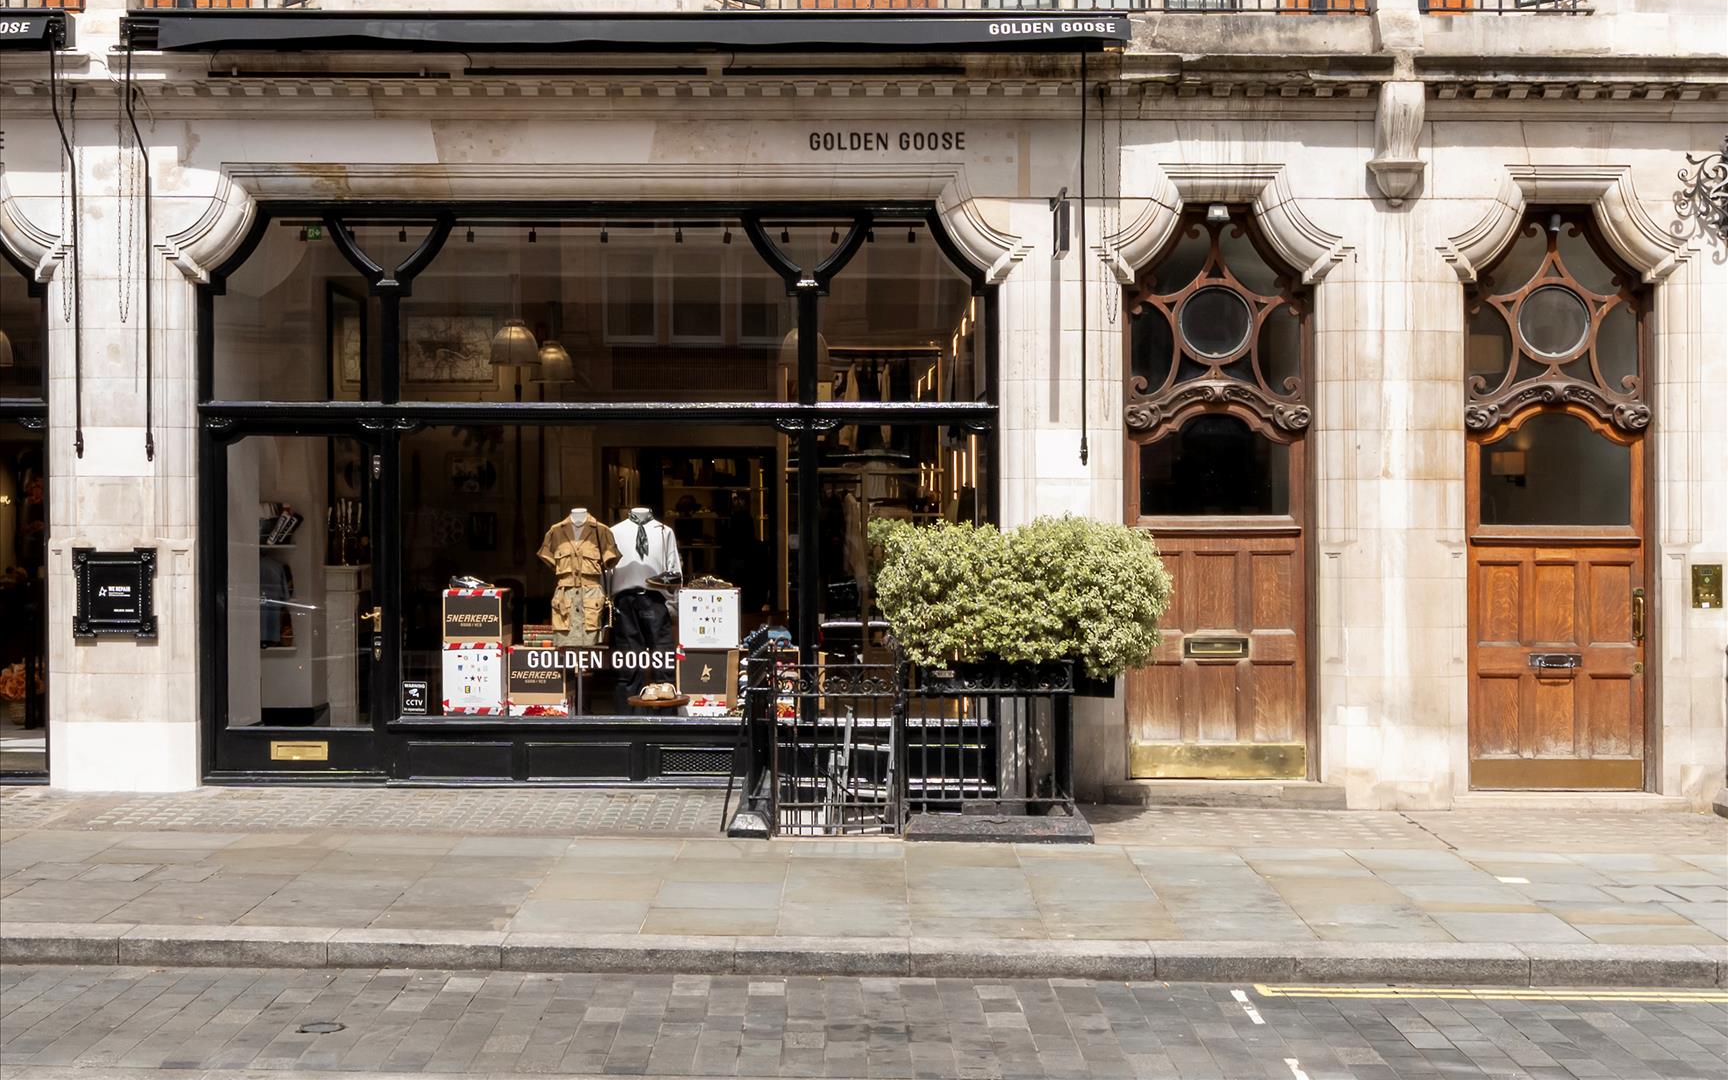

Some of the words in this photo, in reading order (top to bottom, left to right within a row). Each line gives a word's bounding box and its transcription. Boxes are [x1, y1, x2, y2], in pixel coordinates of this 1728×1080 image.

[989, 22, 1054, 35] GOLDEN
[1061, 22, 1116, 33] GOOSE
[809, 132, 889, 151] GOLDEN
[899, 132, 966, 151] GOOSE
[446, 614, 493, 623] SNEAKERS
[527, 650, 603, 669] GOLDEN
[612, 651, 675, 669] GOOSE
[511, 670, 557, 680] SNEAKERS
